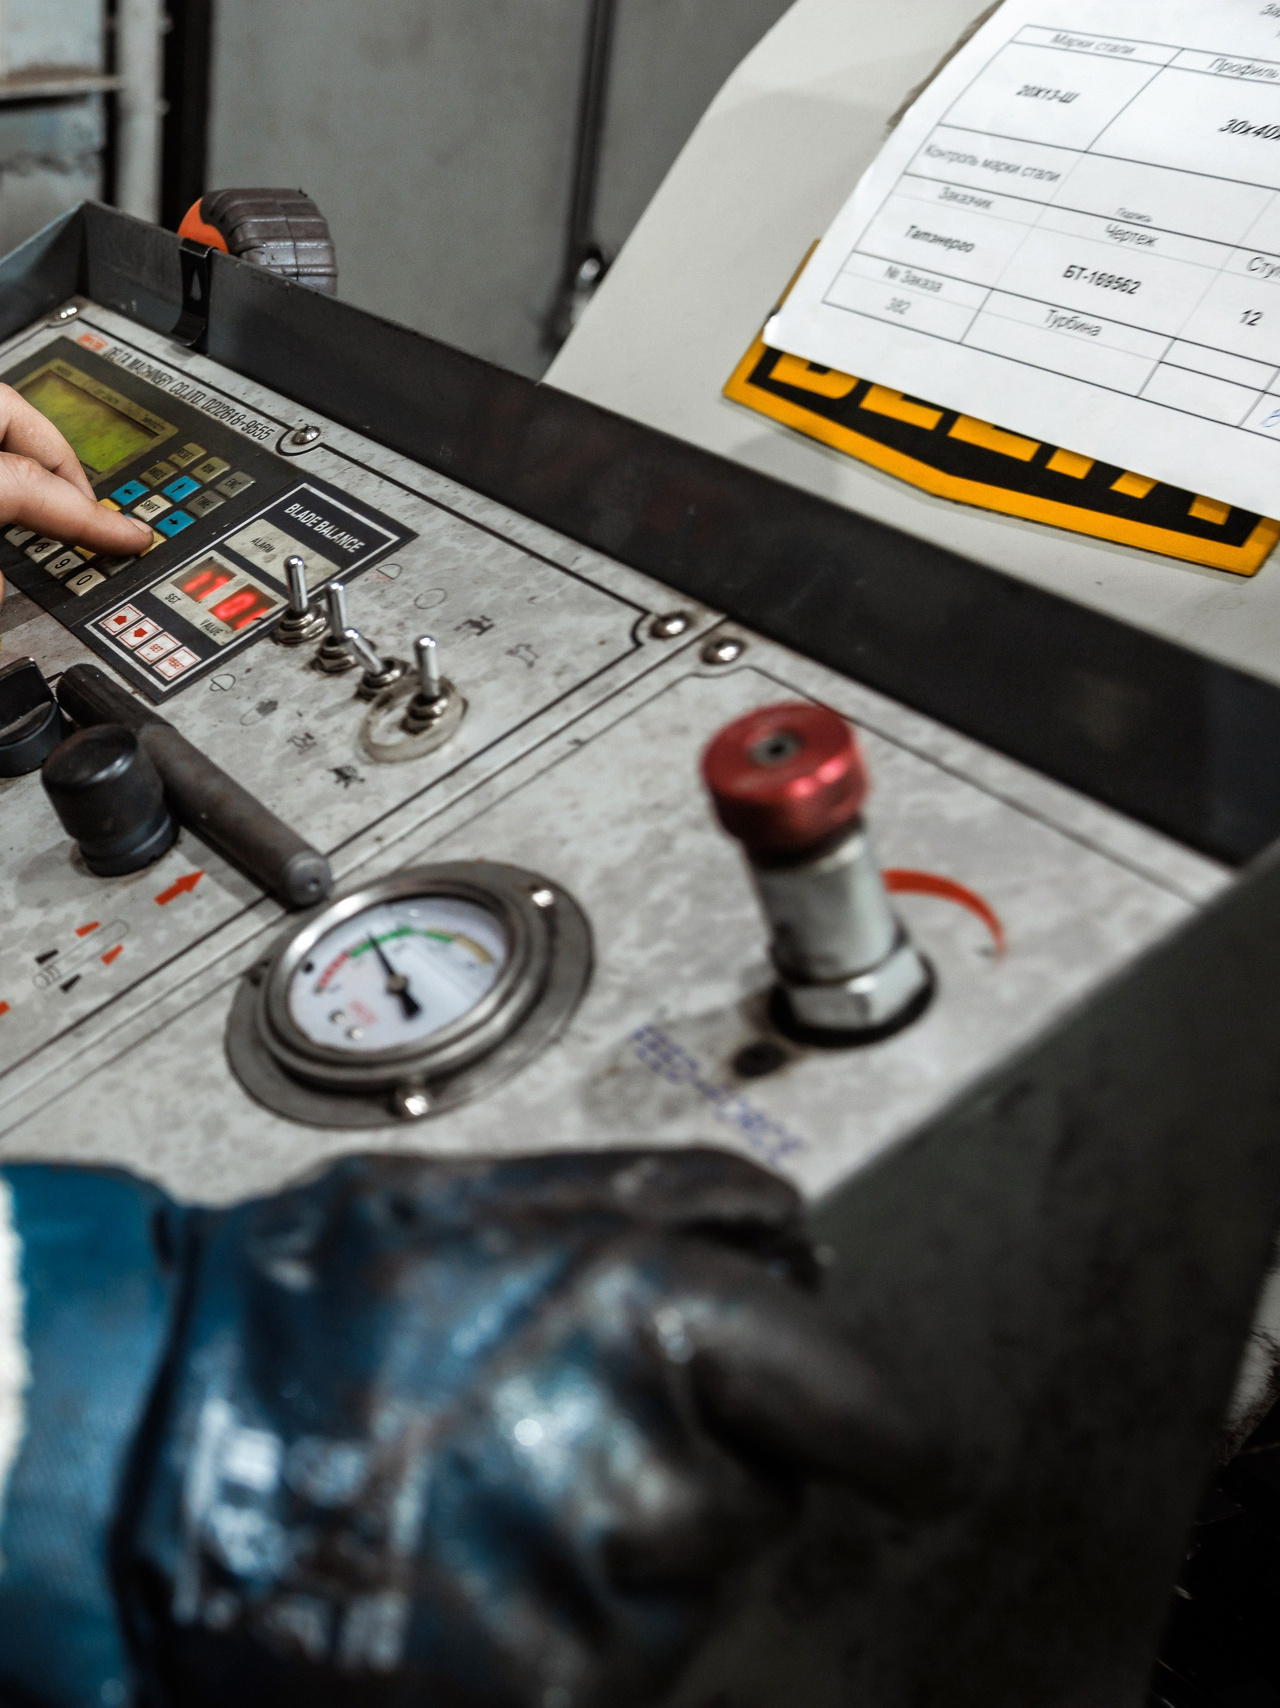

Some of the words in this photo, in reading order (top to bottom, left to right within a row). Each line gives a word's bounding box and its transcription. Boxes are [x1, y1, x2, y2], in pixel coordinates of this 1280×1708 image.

[1095, 42, 1136, 55] стали
[1208, 57, 1279, 78] Профиль
[923, 143, 979, 168] Контроль
[981, 157, 1021, 174] марки
[1021, 164, 1061, 183] стали
[938, 185, 994, 211] Заказчик
[1105, 223, 1159, 247] Чертеж
[884, 265, 901, 280] №
[900, 270, 943, 293] Заказа
[1044, 308, 1102, 337] Турбина
[1238, 308, 1264, 327] 12
[140, 500, 161, 513] SHIFT
[194, 496, 214, 509] TIME
[283, 502, 323, 528] BLADE
[313, 520, 366, 553] BALANCE
[34, 541, 51, 554] 8
[250, 537, 276, 553] ALARM
[55, 557, 71, 569] 9
[76, 574, 93, 586] 0
[165, 593, 182, 605] SET
[199, 618, 224, 637] VALUE
[150, 643, 163, 653] SET
